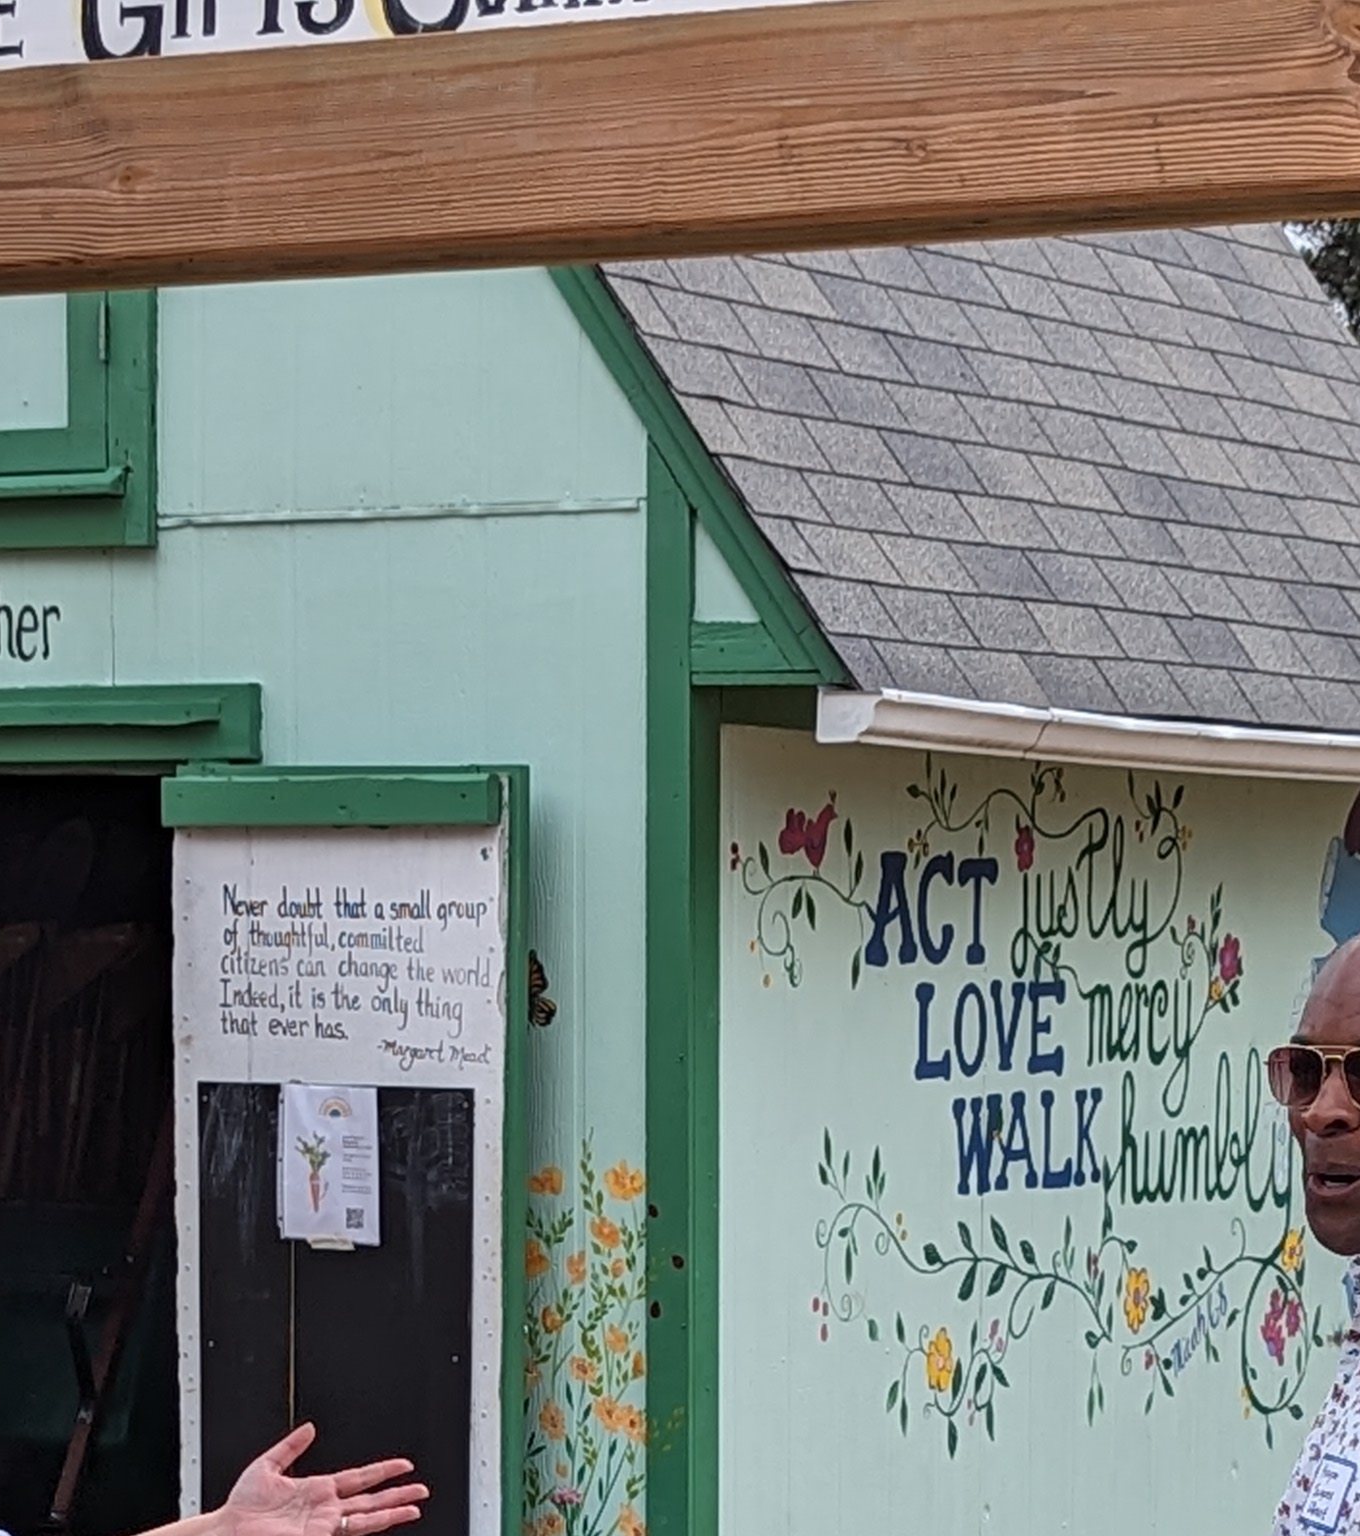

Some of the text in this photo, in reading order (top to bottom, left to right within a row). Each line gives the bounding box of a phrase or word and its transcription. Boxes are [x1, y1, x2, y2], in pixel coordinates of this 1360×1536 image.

[223, 883, 487, 932] Never doubt that a small group
[865, 812, 1160, 979] ACT justly
[224, 918, 239, 955] of
[249, 919, 335, 961] thoughtful,
[221, 945, 289, 977] citizens
[297, 958, 326, 977] can
[338, 950, 398, 994] change
[407, 956, 435, 982] the
[219, 978, 463, 1039] Indeed, it is the only thing
[220, 1009, 349, 1039] that ever has.
[914, 979, 1193, 1118] LOVE mercy
[952, 1047, 1293, 1242] WALK humbly
